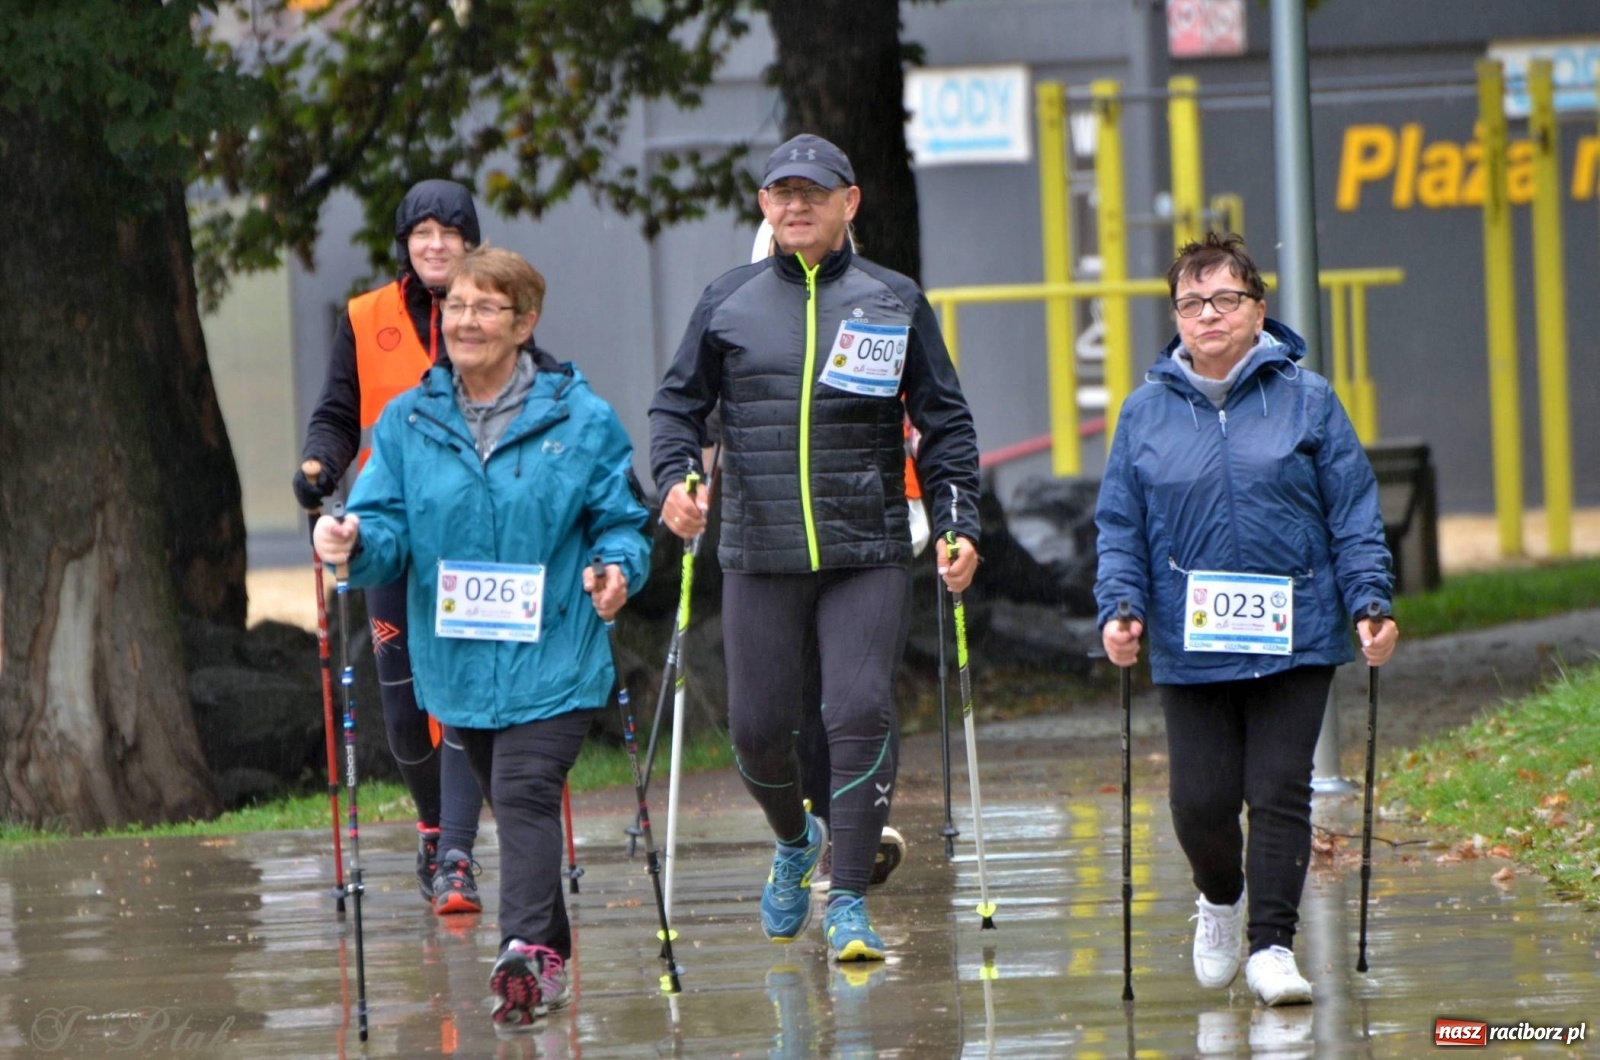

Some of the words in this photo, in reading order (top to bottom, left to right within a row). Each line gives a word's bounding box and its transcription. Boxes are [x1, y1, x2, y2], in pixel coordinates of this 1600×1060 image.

[921, 76, 1014, 129] LODY
[857, 337, 895, 362] 060
[465, 576, 515, 603] 026
[1213, 592, 1266, 619] 023
